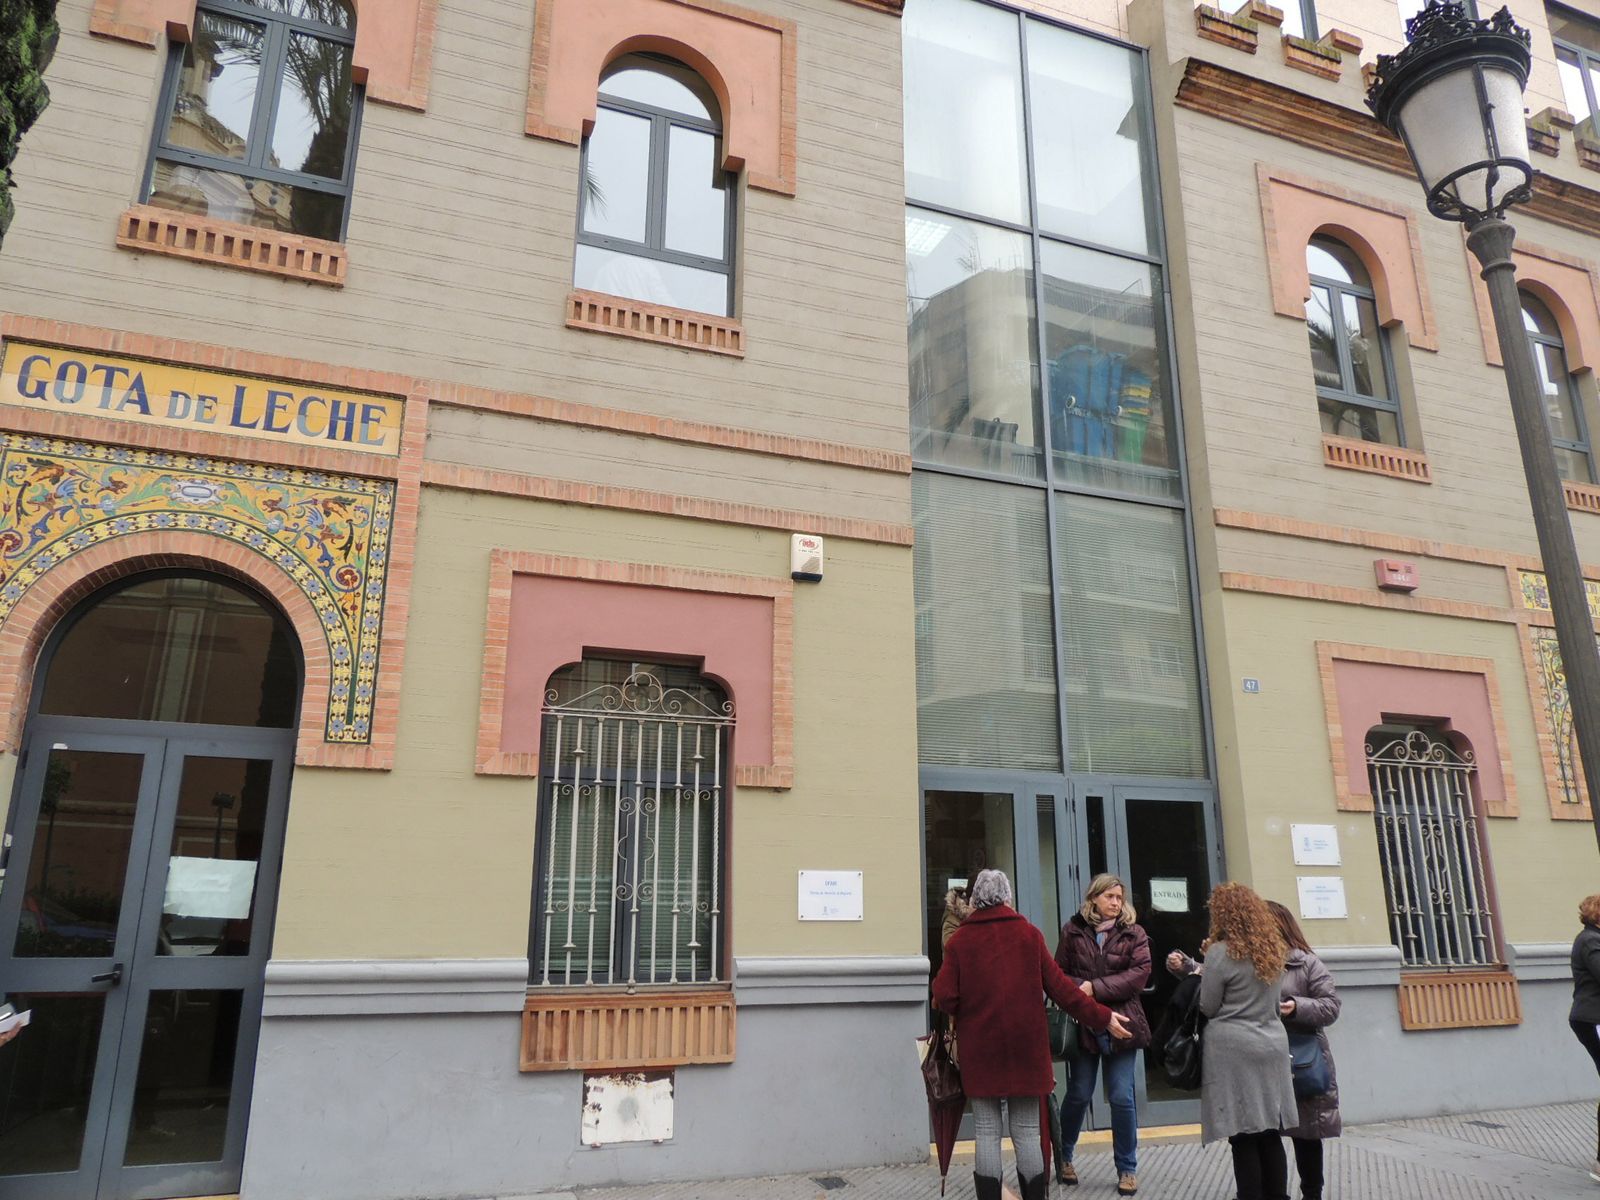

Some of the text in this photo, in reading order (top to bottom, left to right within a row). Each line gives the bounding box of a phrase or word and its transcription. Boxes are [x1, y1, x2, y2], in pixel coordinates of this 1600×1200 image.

[16, 354, 387, 446] GOTA DE LECHE
[1153, 891, 1187, 899] ENTRADA
